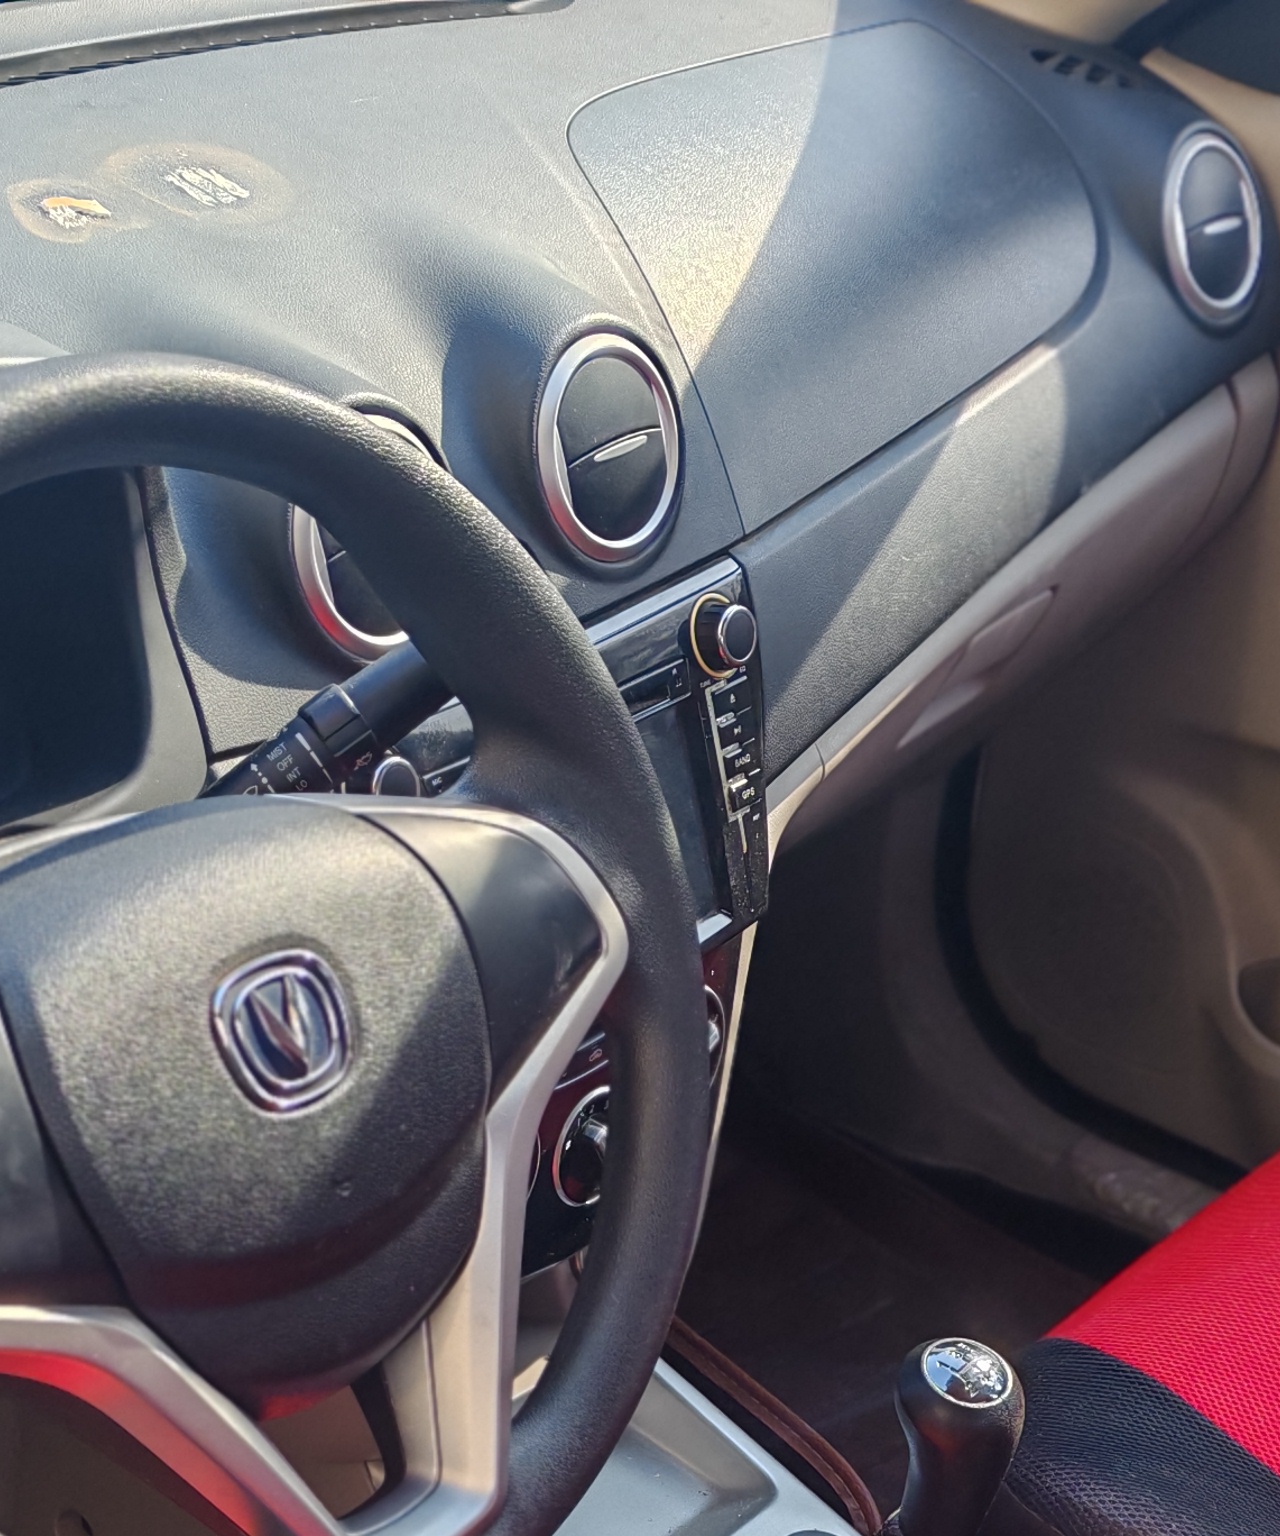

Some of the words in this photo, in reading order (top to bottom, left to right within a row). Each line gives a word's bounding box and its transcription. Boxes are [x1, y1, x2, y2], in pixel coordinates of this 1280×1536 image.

[266, 741, 288, 761] MIST
[276, 754, 294, 771] OFF
[286, 766, 302, 783] INT
[295, 779, 308, 792] LO
[741, 786, 756, 800] GPS
